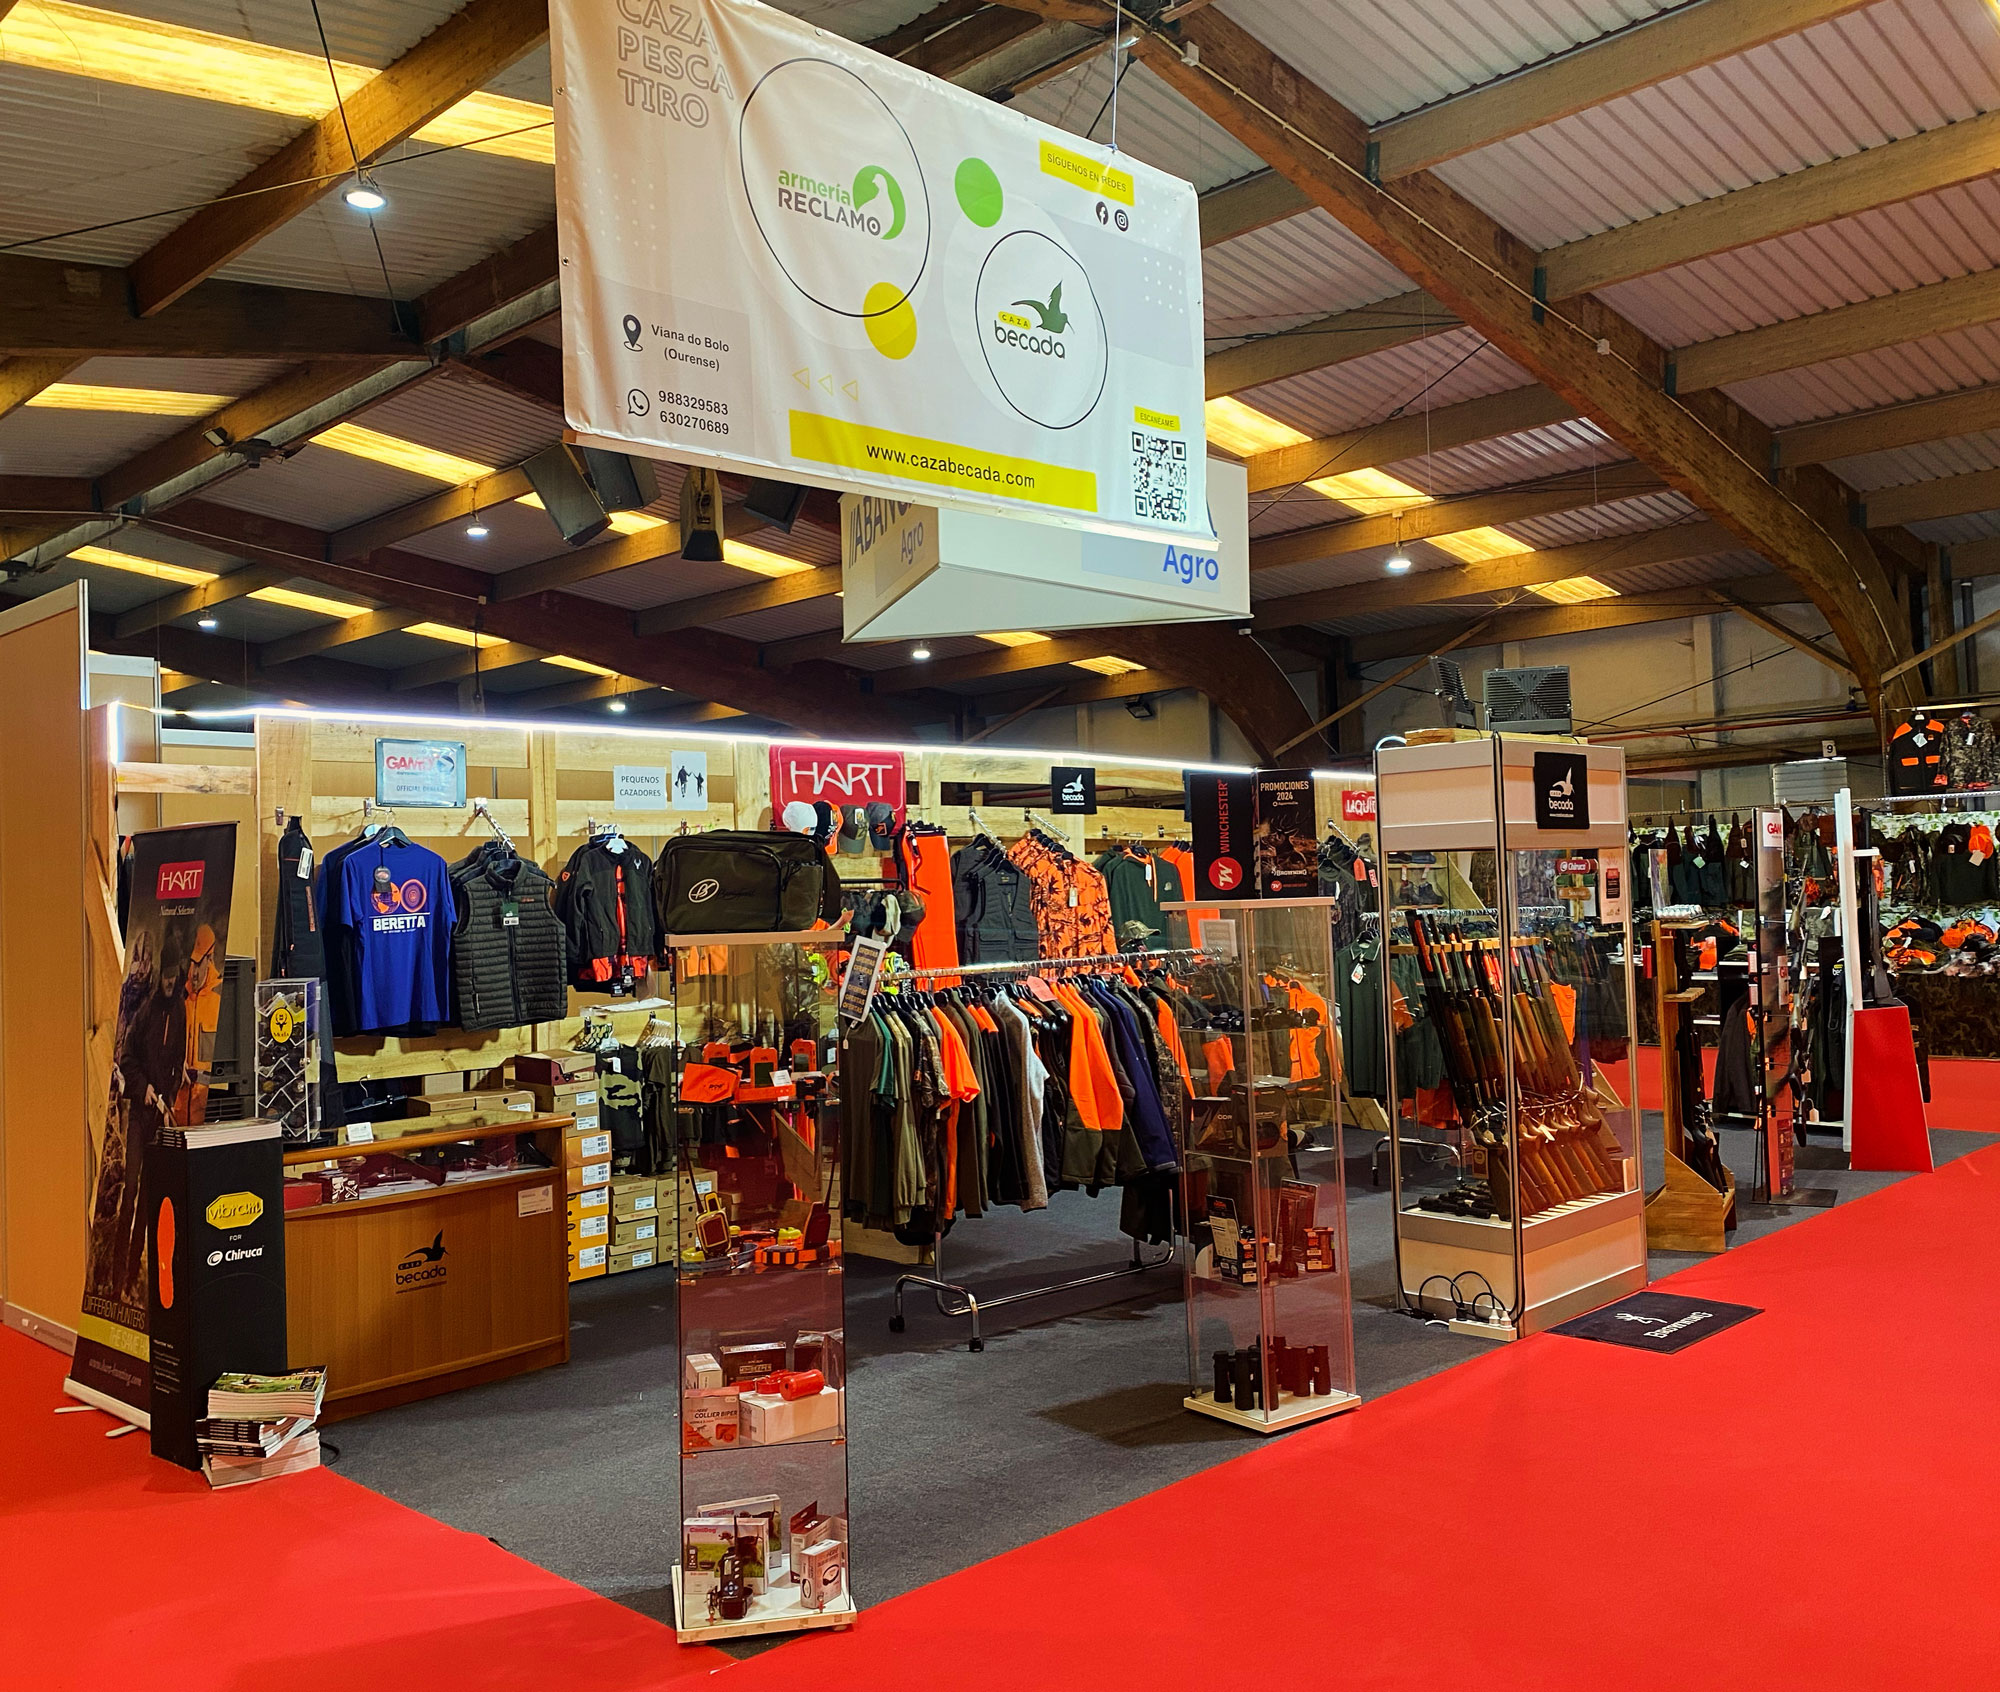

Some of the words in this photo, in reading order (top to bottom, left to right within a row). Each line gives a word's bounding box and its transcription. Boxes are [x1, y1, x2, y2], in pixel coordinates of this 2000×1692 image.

[616, 0, 718, 55] CAZA
[617, 25, 735, 101] PESCA
[617, 68, 709, 128] TIRO
[1047, 153, 1088, 177] SÍGUENOS
[1089, 170, 1099, 183] EN
[1101, 175, 1127, 192] REDES
[778, 187, 881, 236] RECLAMO
[1001, 314, 1029, 328] CAZA
[651, 324, 685, 342] Viana
[687, 333, 702, 346] do
[704, 337, 730, 353] Bolo
[994, 319, 1066, 359] becada
[664, 347, 721, 372] (Ourense)
[658, 390, 730, 416] 988329583
[659, 410, 730, 436] 630270689
[866, 444, 1036, 489] www.cazabecada.com
[900, 521, 924, 565] Agro
[1162, 544, 1220, 585] Agro
[1826, 744, 1834, 754] 9
[790, 761, 894, 797] HART
[1260, 780, 1310, 792] PROMOCIONES
[619, 788, 662, 797] CAZADORES
[1276, 791, 1294, 801] 2024
[1548, 797, 1574, 811] becada
[1218, 780, 1231, 854] WINCHESTER
[160, 869, 202, 892] HART
[373, 915, 427, 932] BERETTA
[225, 1247, 263, 1262] Chiruca
[395, 1265, 447, 1286] becada
[116, 1303, 146, 1330] HUNTERS
[694, 1410, 721, 1419] COLLIER
